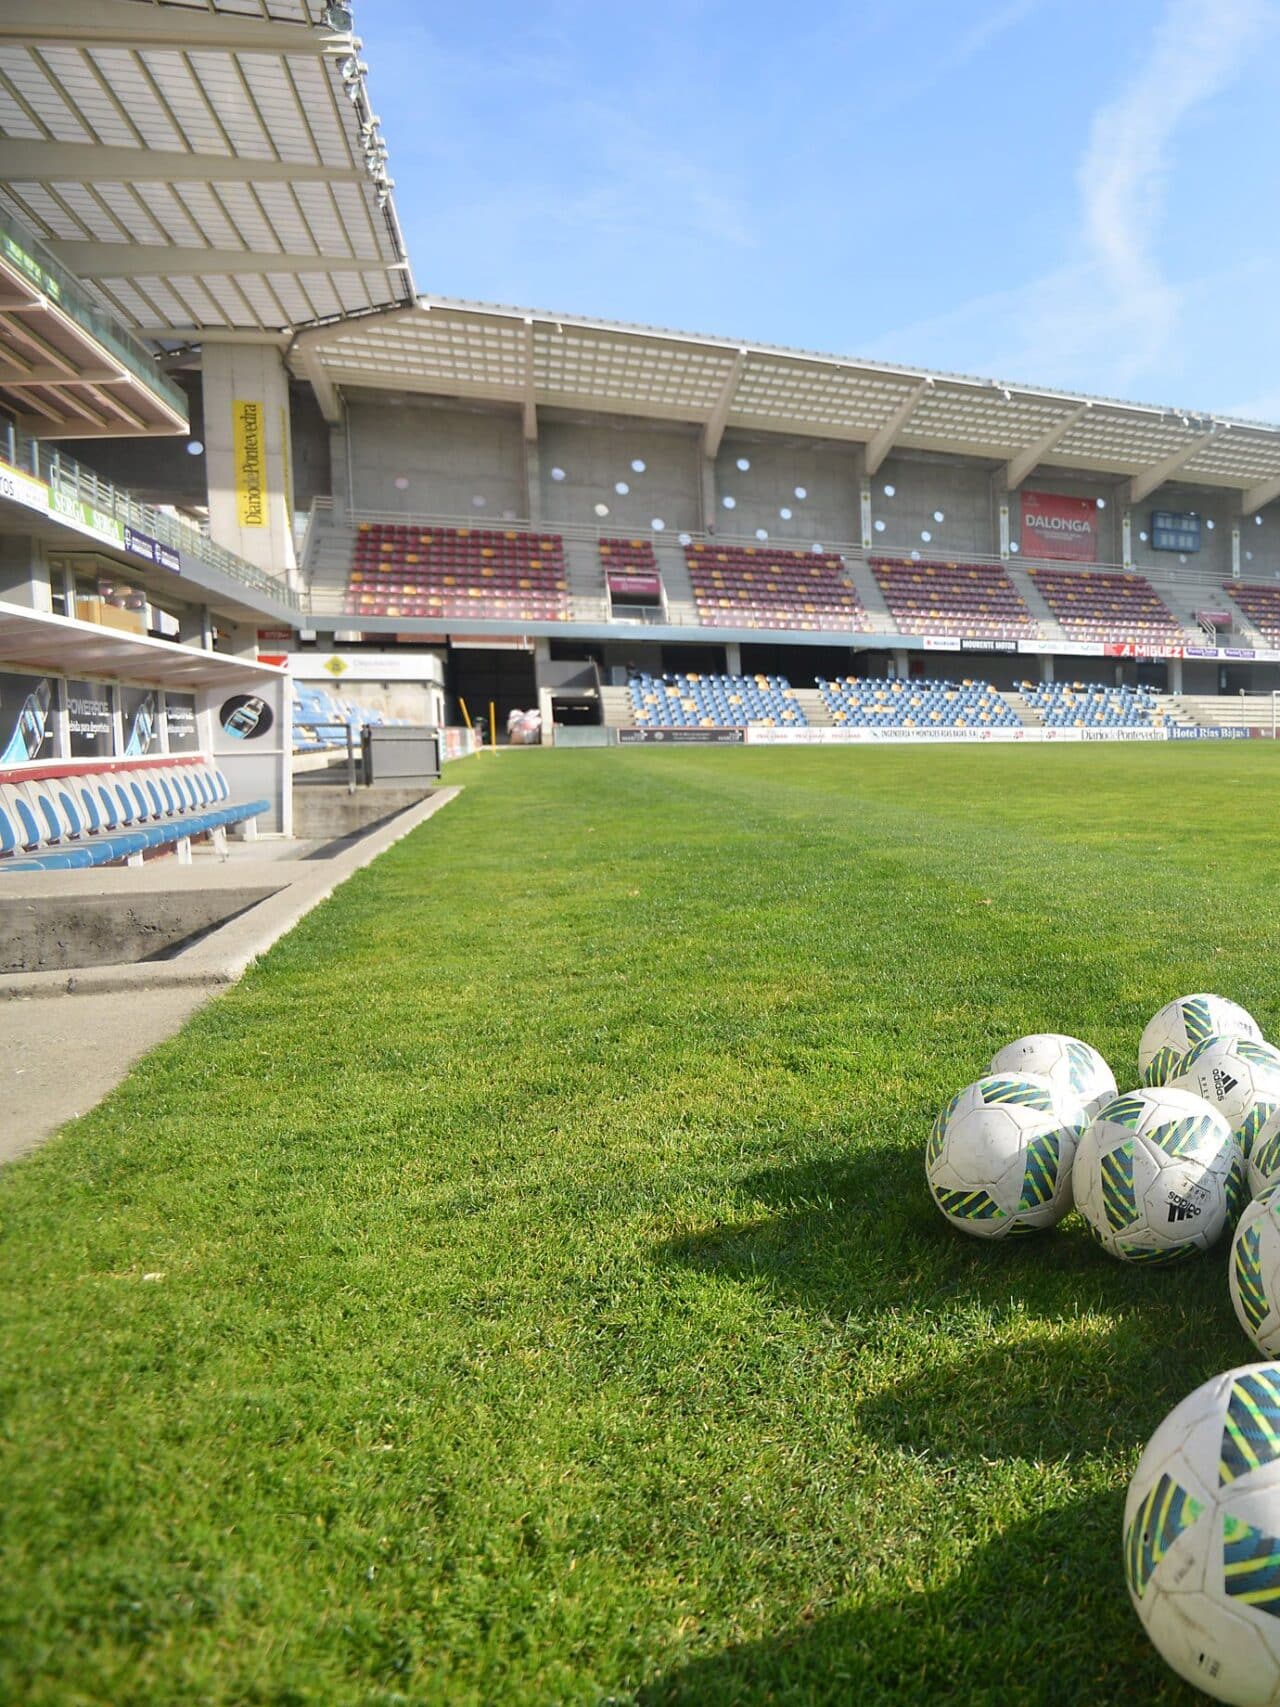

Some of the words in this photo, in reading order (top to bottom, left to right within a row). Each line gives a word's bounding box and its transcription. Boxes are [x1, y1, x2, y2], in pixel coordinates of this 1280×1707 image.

[1024, 513, 1092, 533] DALONGA
[1173, 728, 1198, 739] Hotel
[1212, 1068, 1225, 1101] adidas
[1168, 1191, 1202, 1216] adidas
